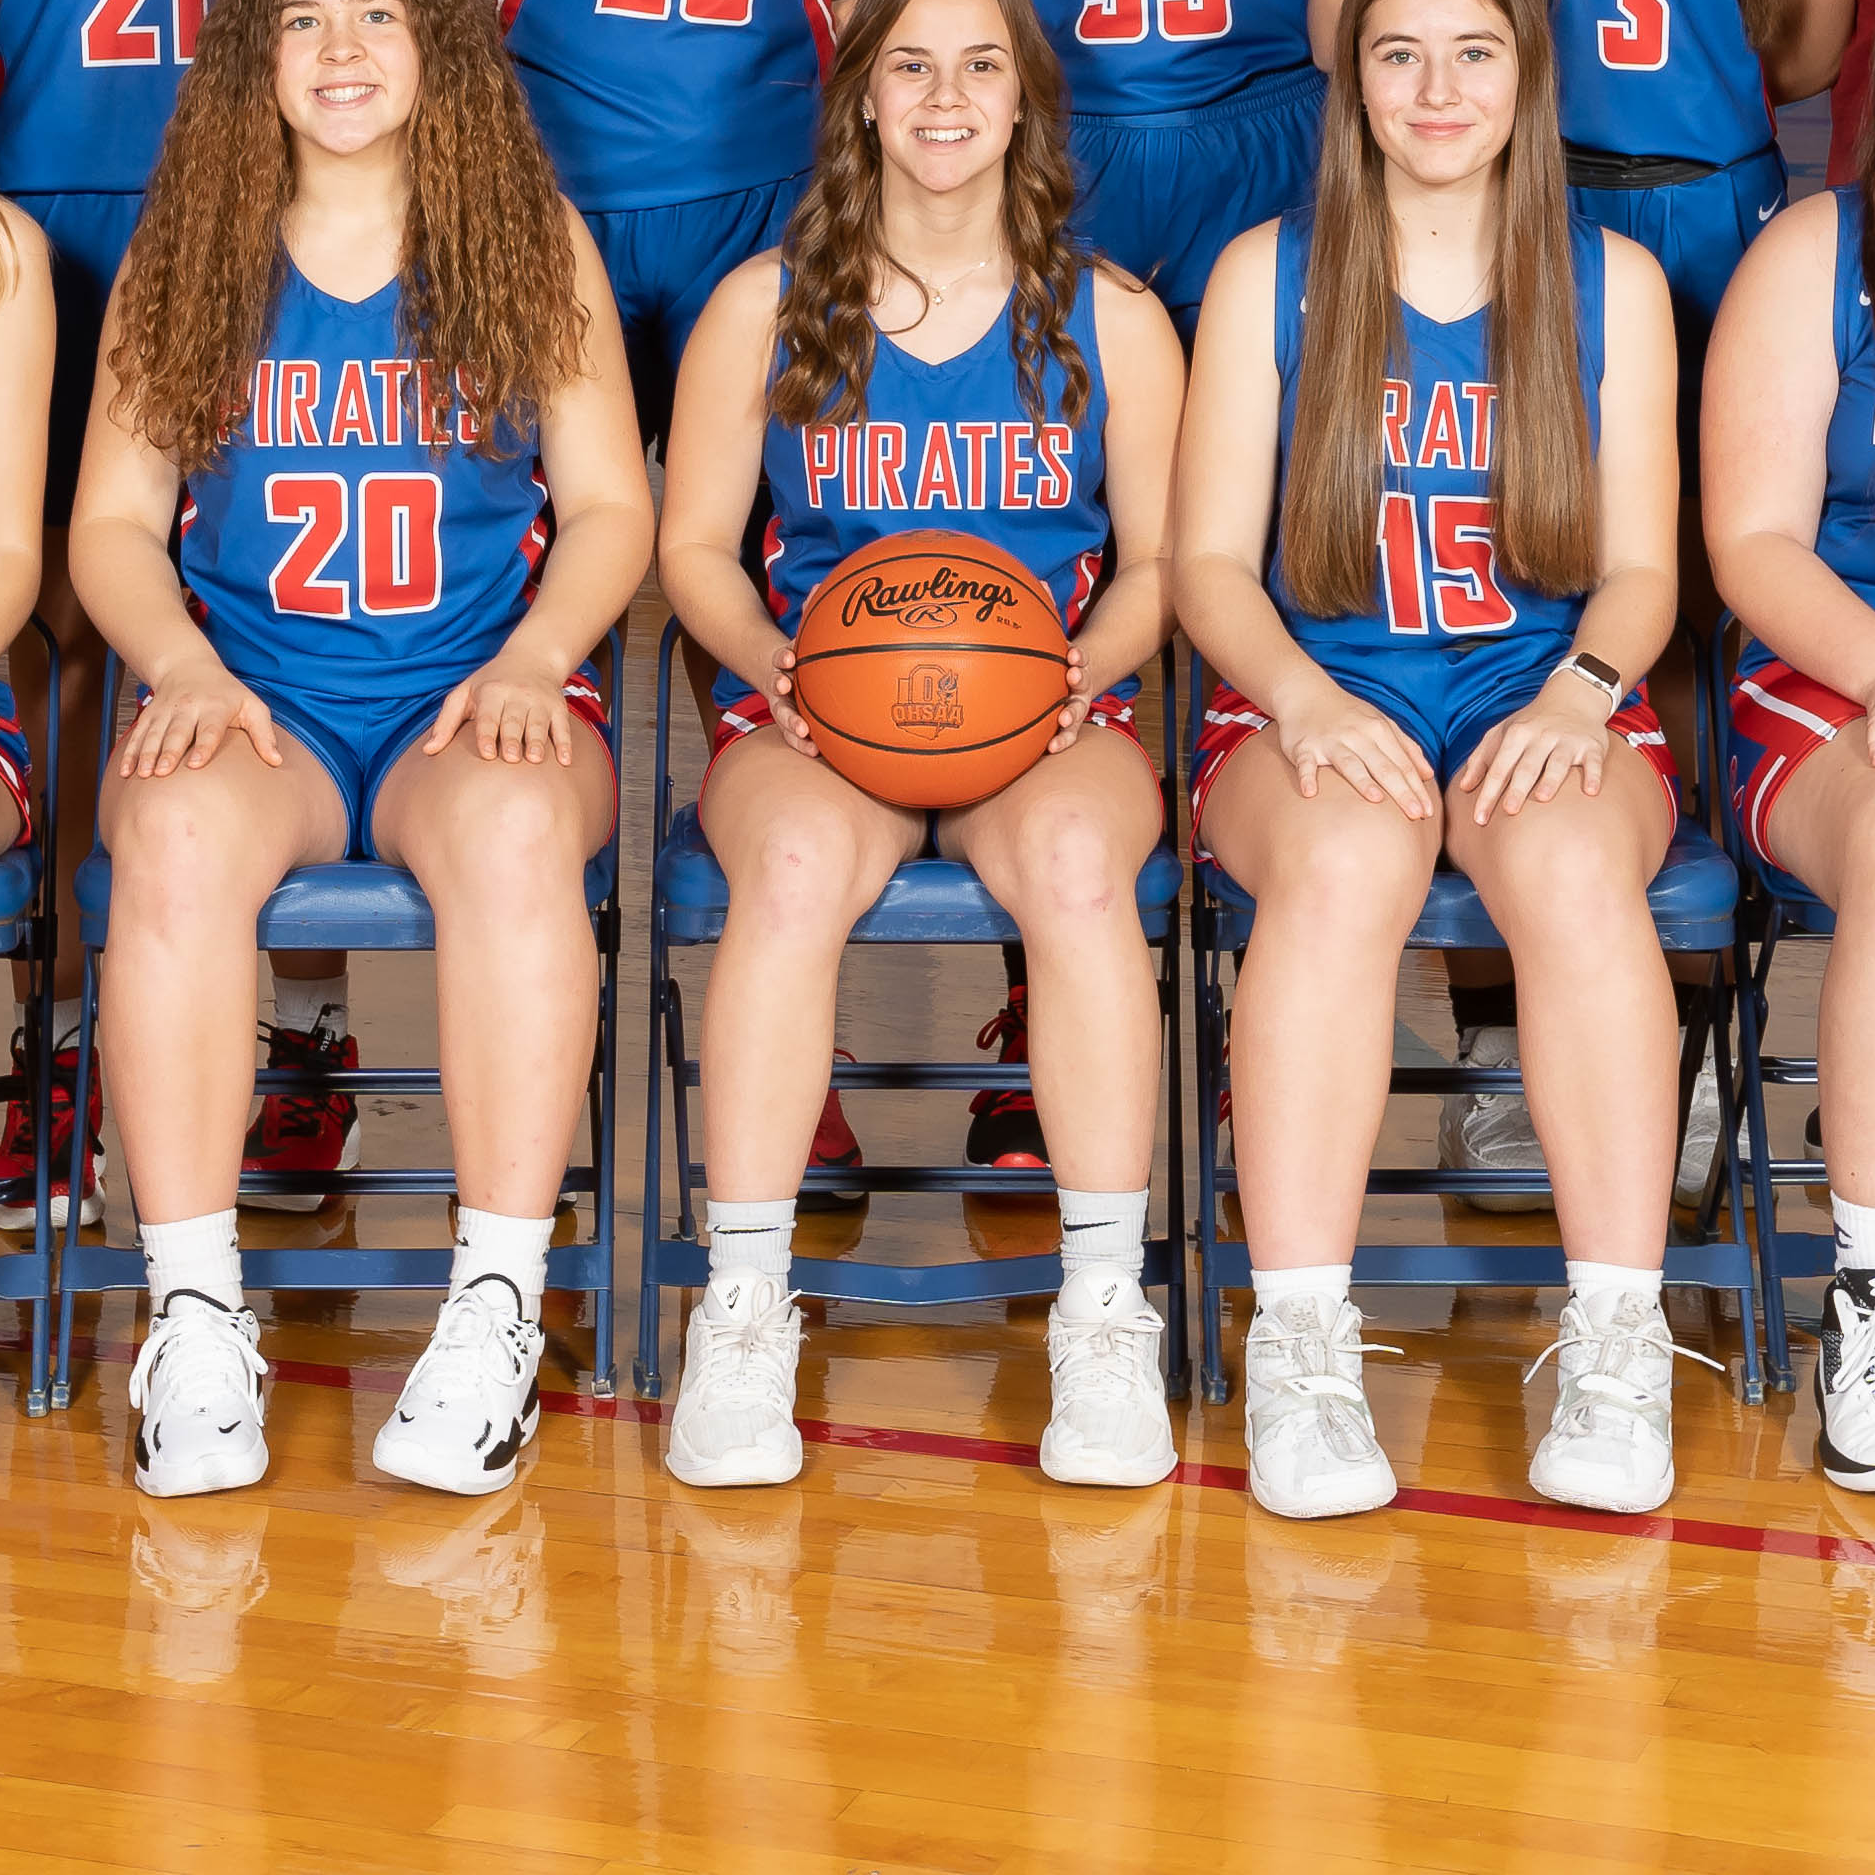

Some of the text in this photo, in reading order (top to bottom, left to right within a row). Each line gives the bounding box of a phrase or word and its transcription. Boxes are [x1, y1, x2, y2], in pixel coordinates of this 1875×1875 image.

[801, 421, 1074, 511] PIRATES
[264, 472, 443, 621] 20
[1376, 491, 1518, 635] 15
[842, 567, 1019, 628] Rawlings
[892, 704, 963, 725] OHSAA
